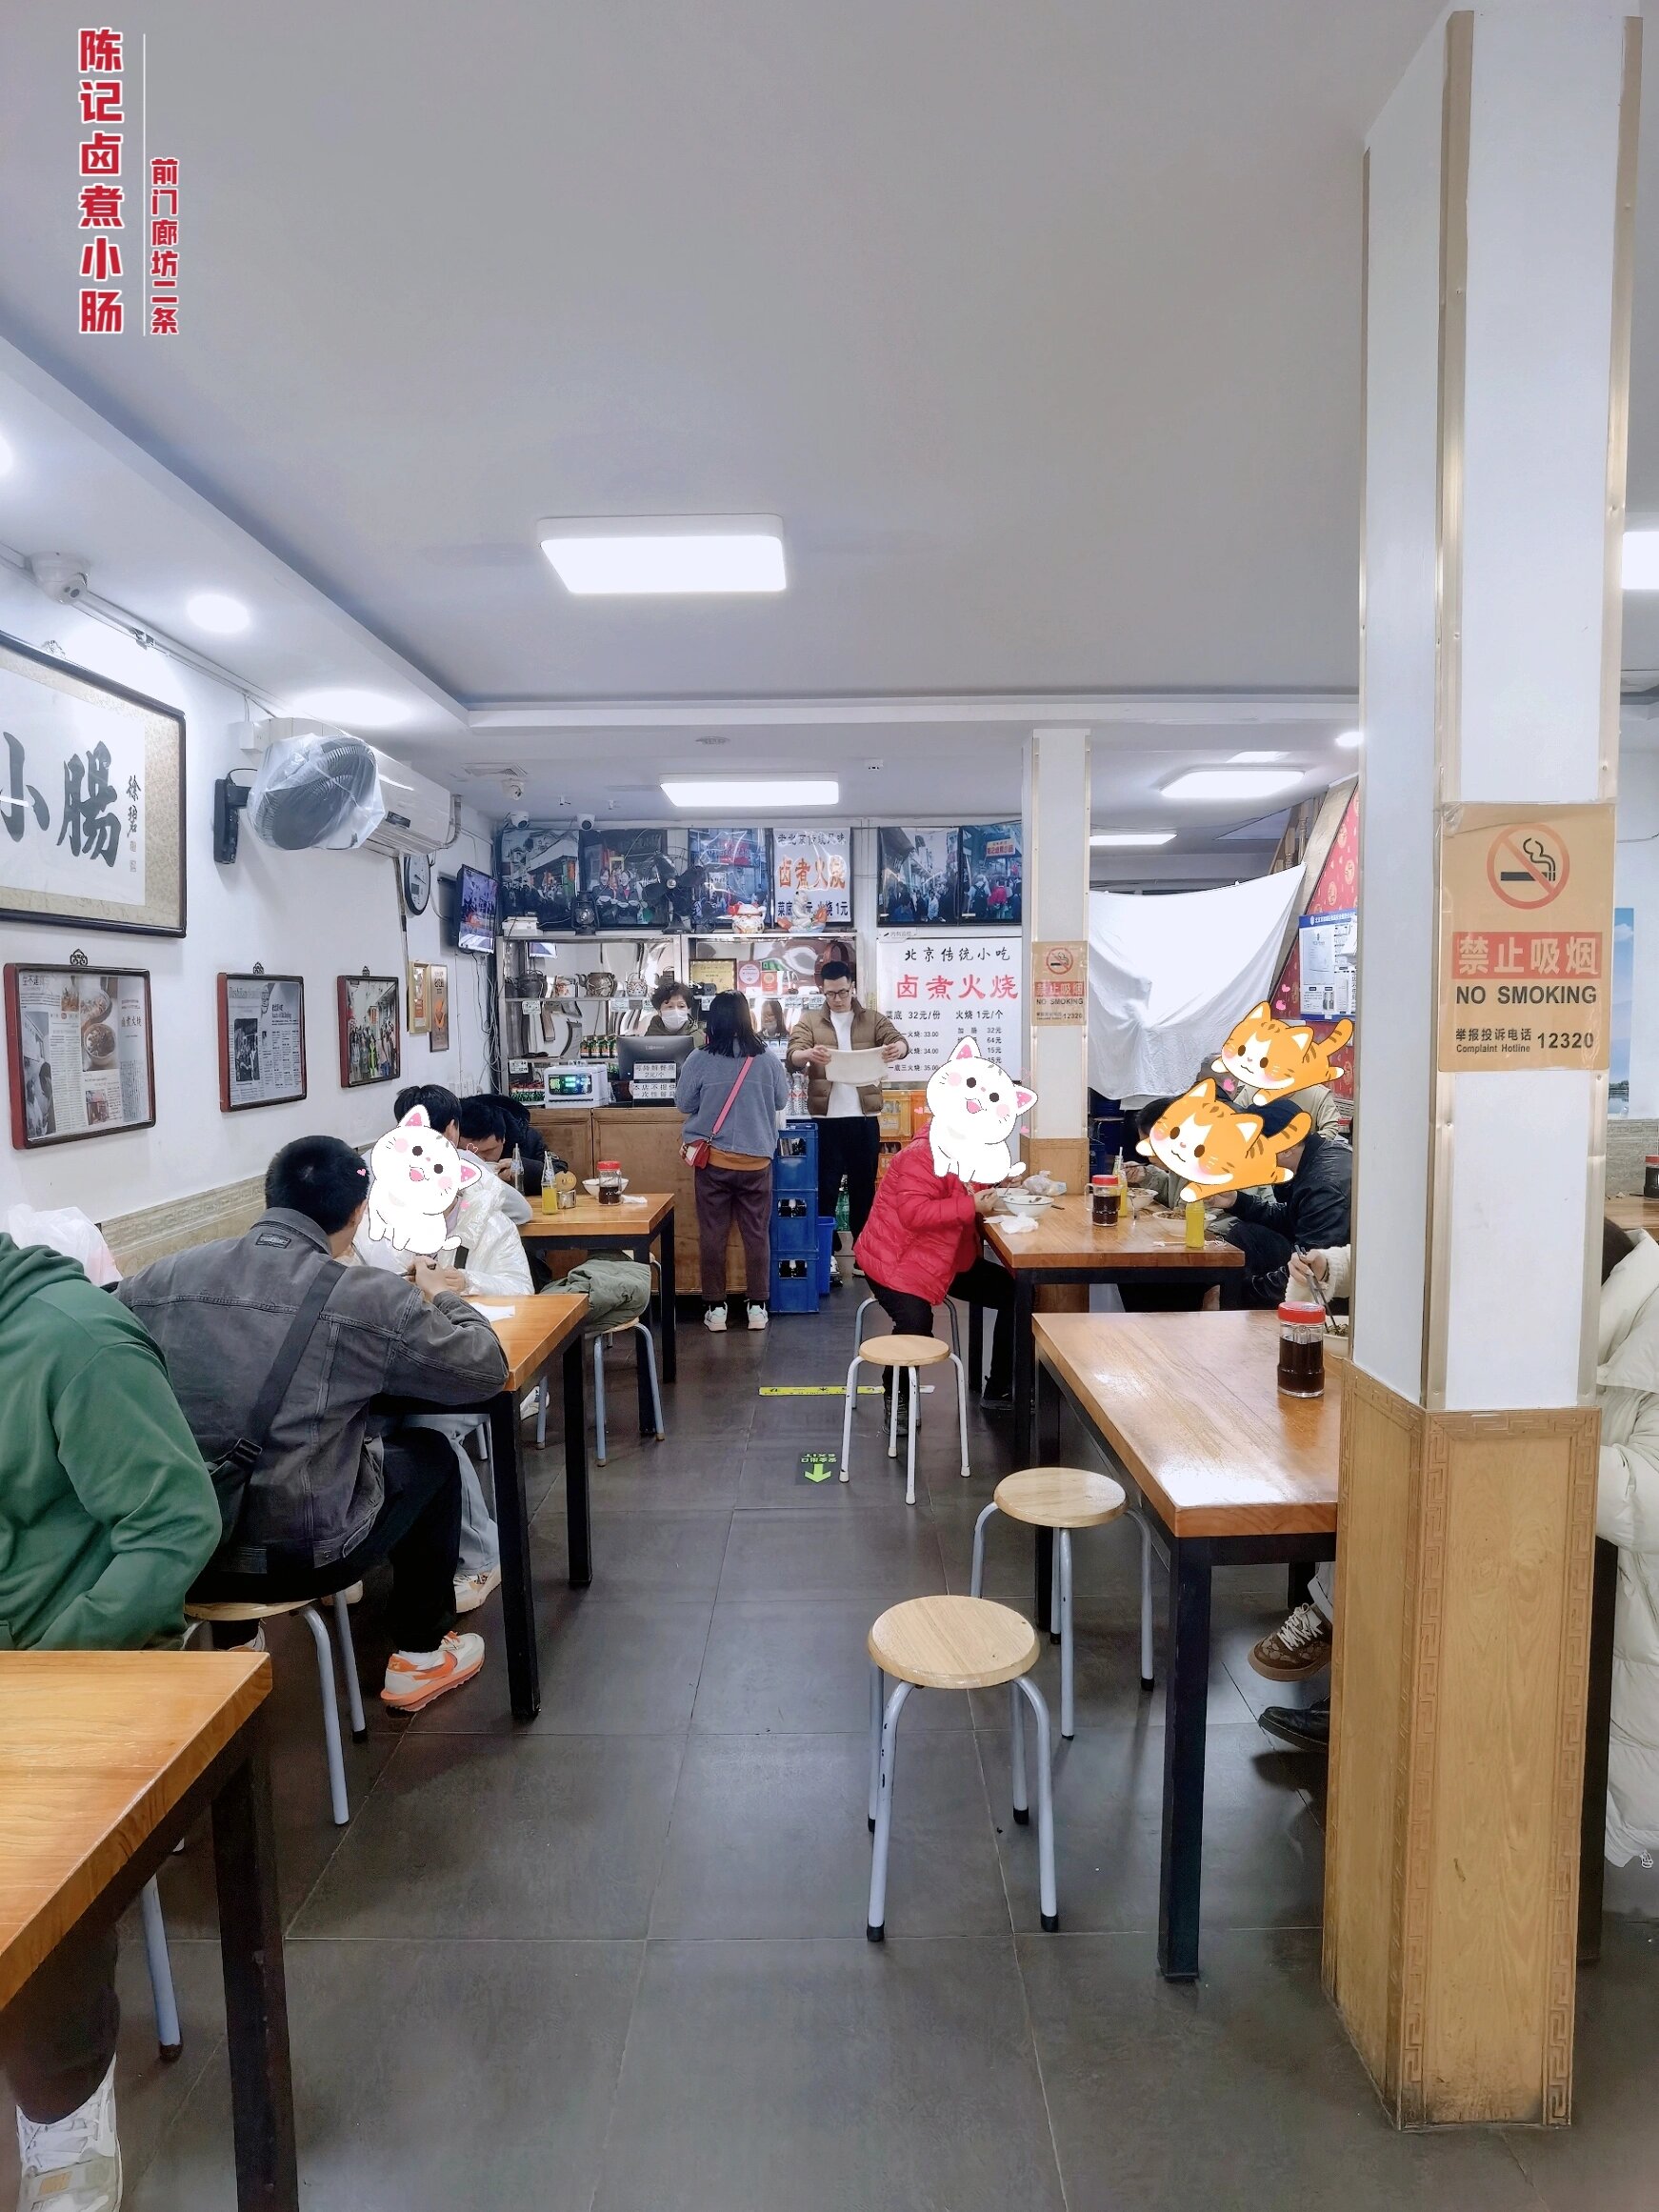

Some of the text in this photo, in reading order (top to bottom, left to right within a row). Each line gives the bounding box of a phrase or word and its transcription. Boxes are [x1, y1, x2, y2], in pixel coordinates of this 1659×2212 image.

[904, 946, 1011, 962] 北京传统小吃
[1458, 936, 1599, 975] 禁止吸烟
[897, 974, 1019, 1000] 卤煮火烧
[1456, 985, 1597, 1005] NO SMOKING
[955, 1010, 973, 1020] 火烧
[1456, 1028, 1594, 1049] 举报投诉电话 12320
[1456, 1044, 1531, 1054] Complaint Hotline
